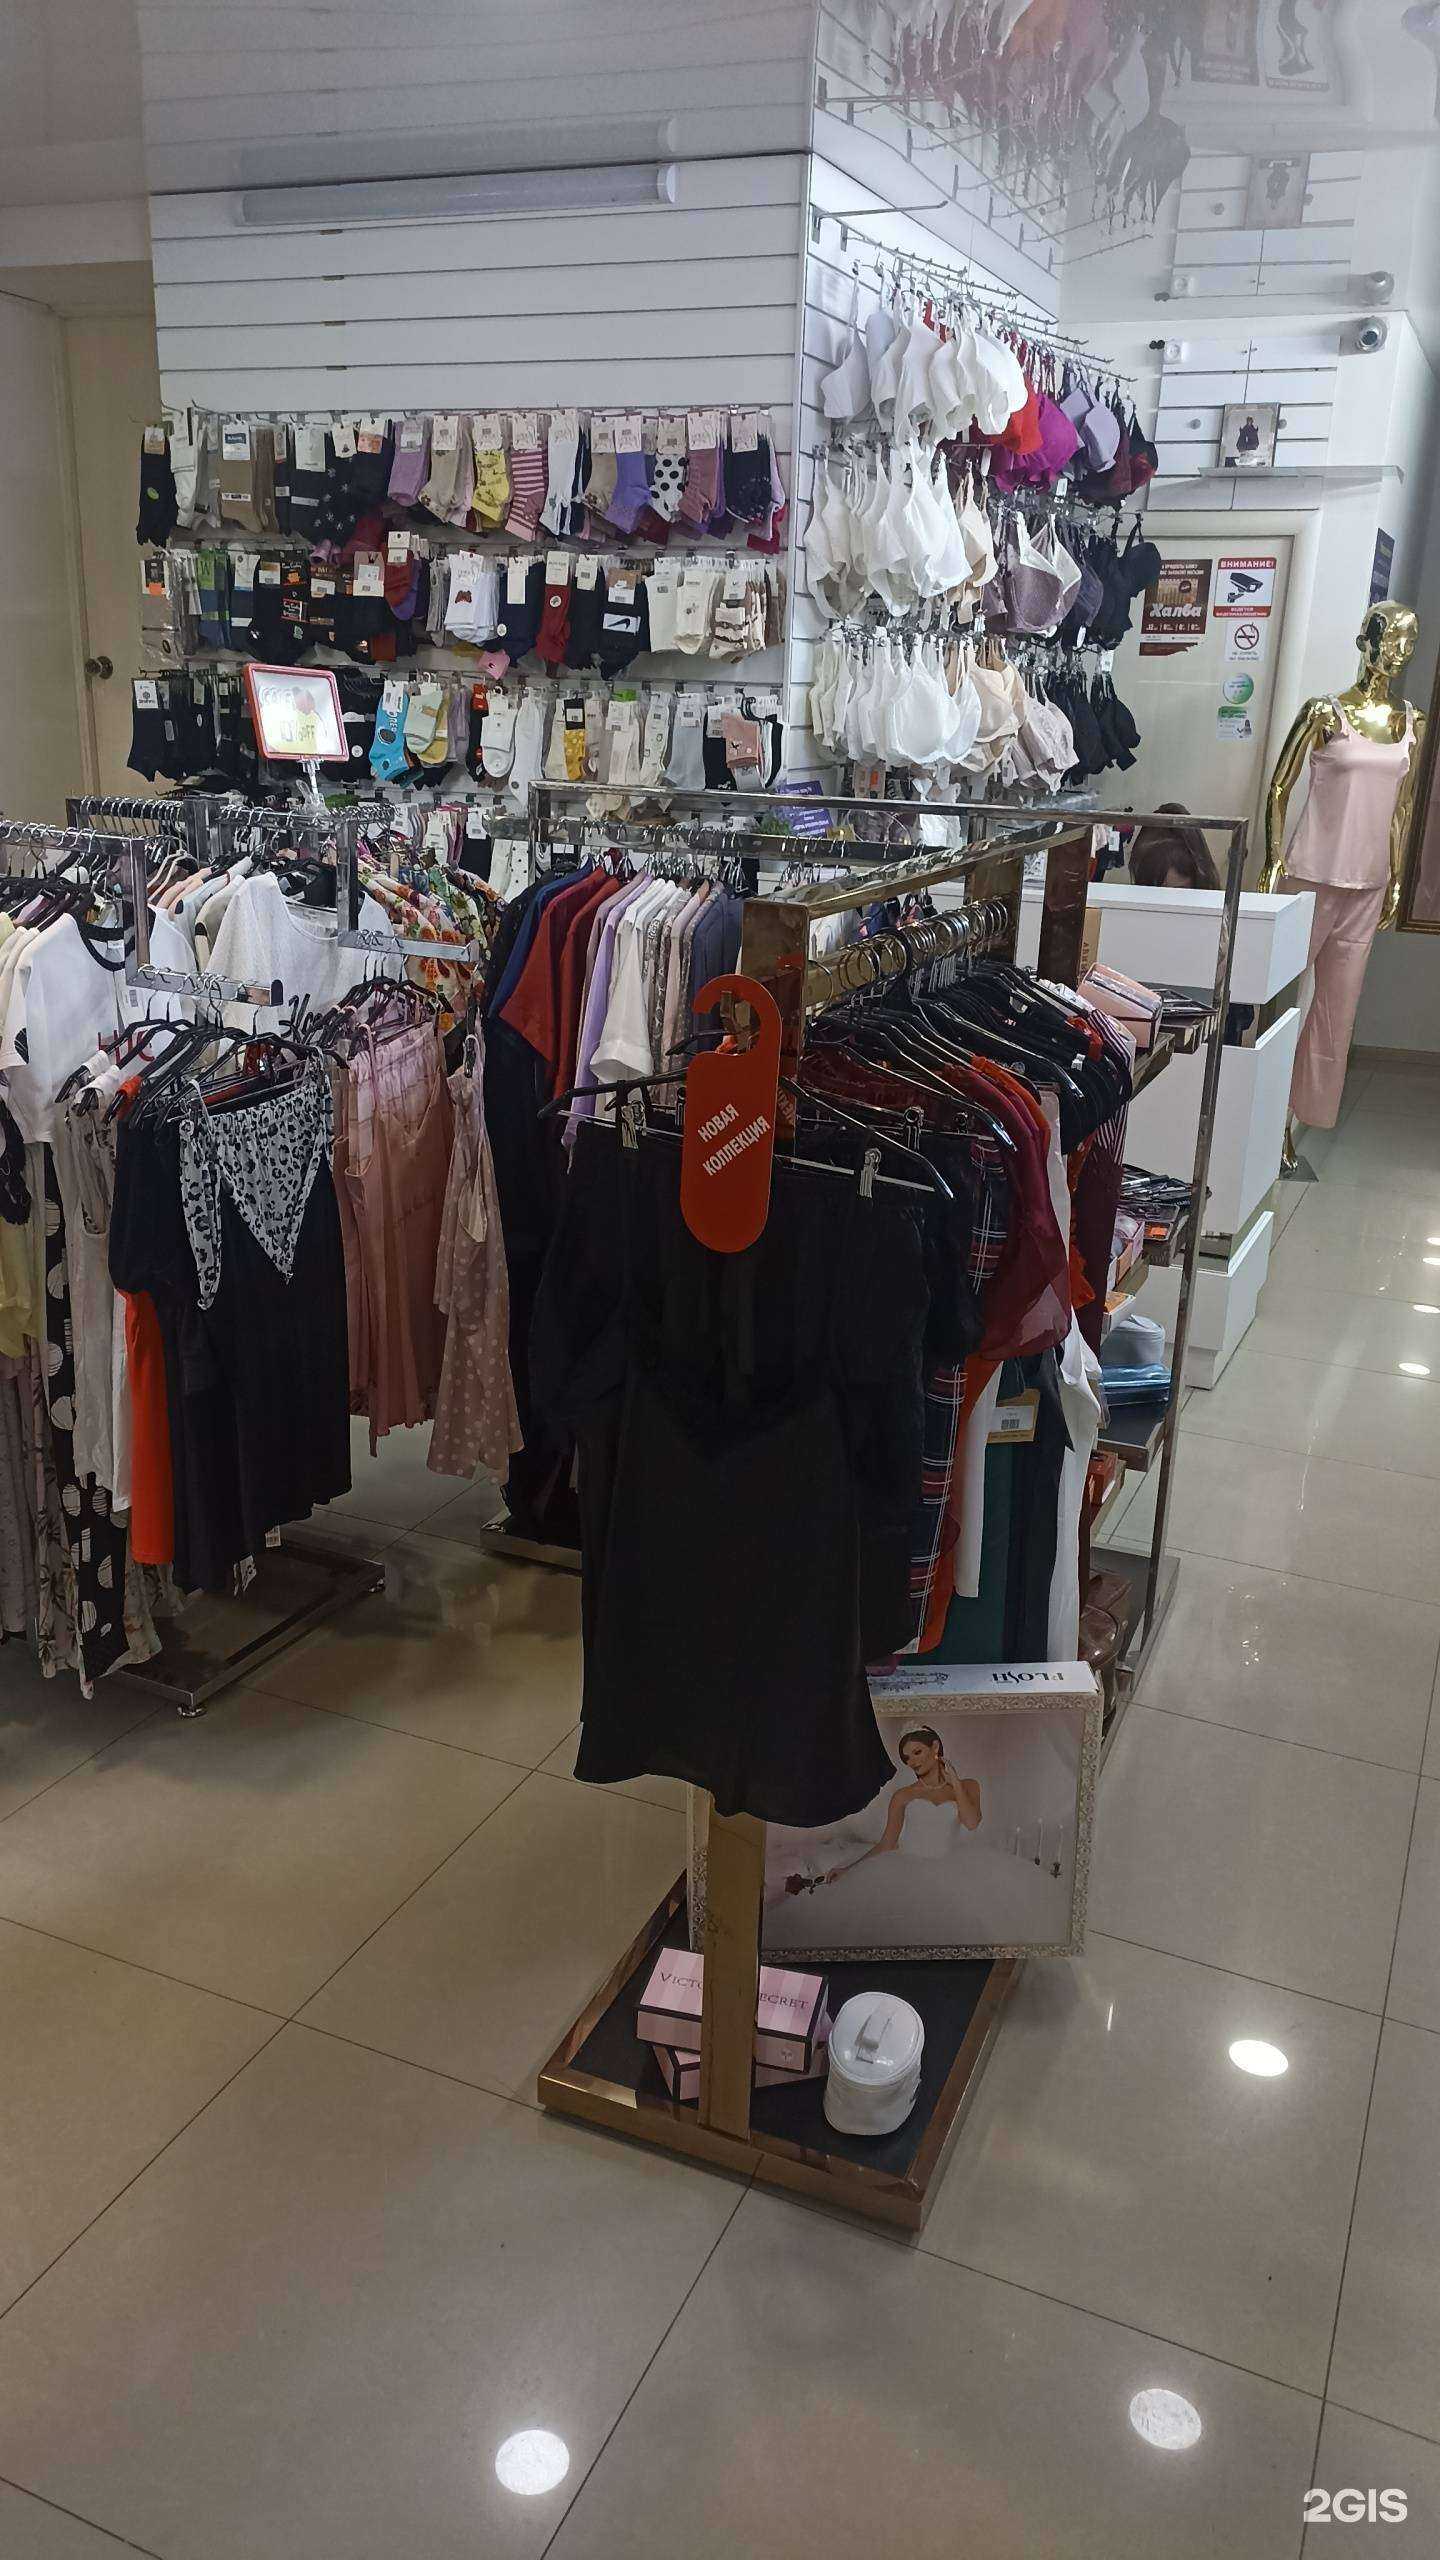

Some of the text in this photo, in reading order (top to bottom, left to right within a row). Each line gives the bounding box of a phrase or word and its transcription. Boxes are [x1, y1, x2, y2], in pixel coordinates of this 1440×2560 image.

[1220, 560, 1274, 568] ВНИМАНИЕ!
[1149, 603, 1202, 618] Халва
[697, 1103, 740, 1142] НОВАЯ
[702, 1115, 771, 1176] КОЛЛЕКЦИЯ
[759, 1993, 809, 2010] ECRET
